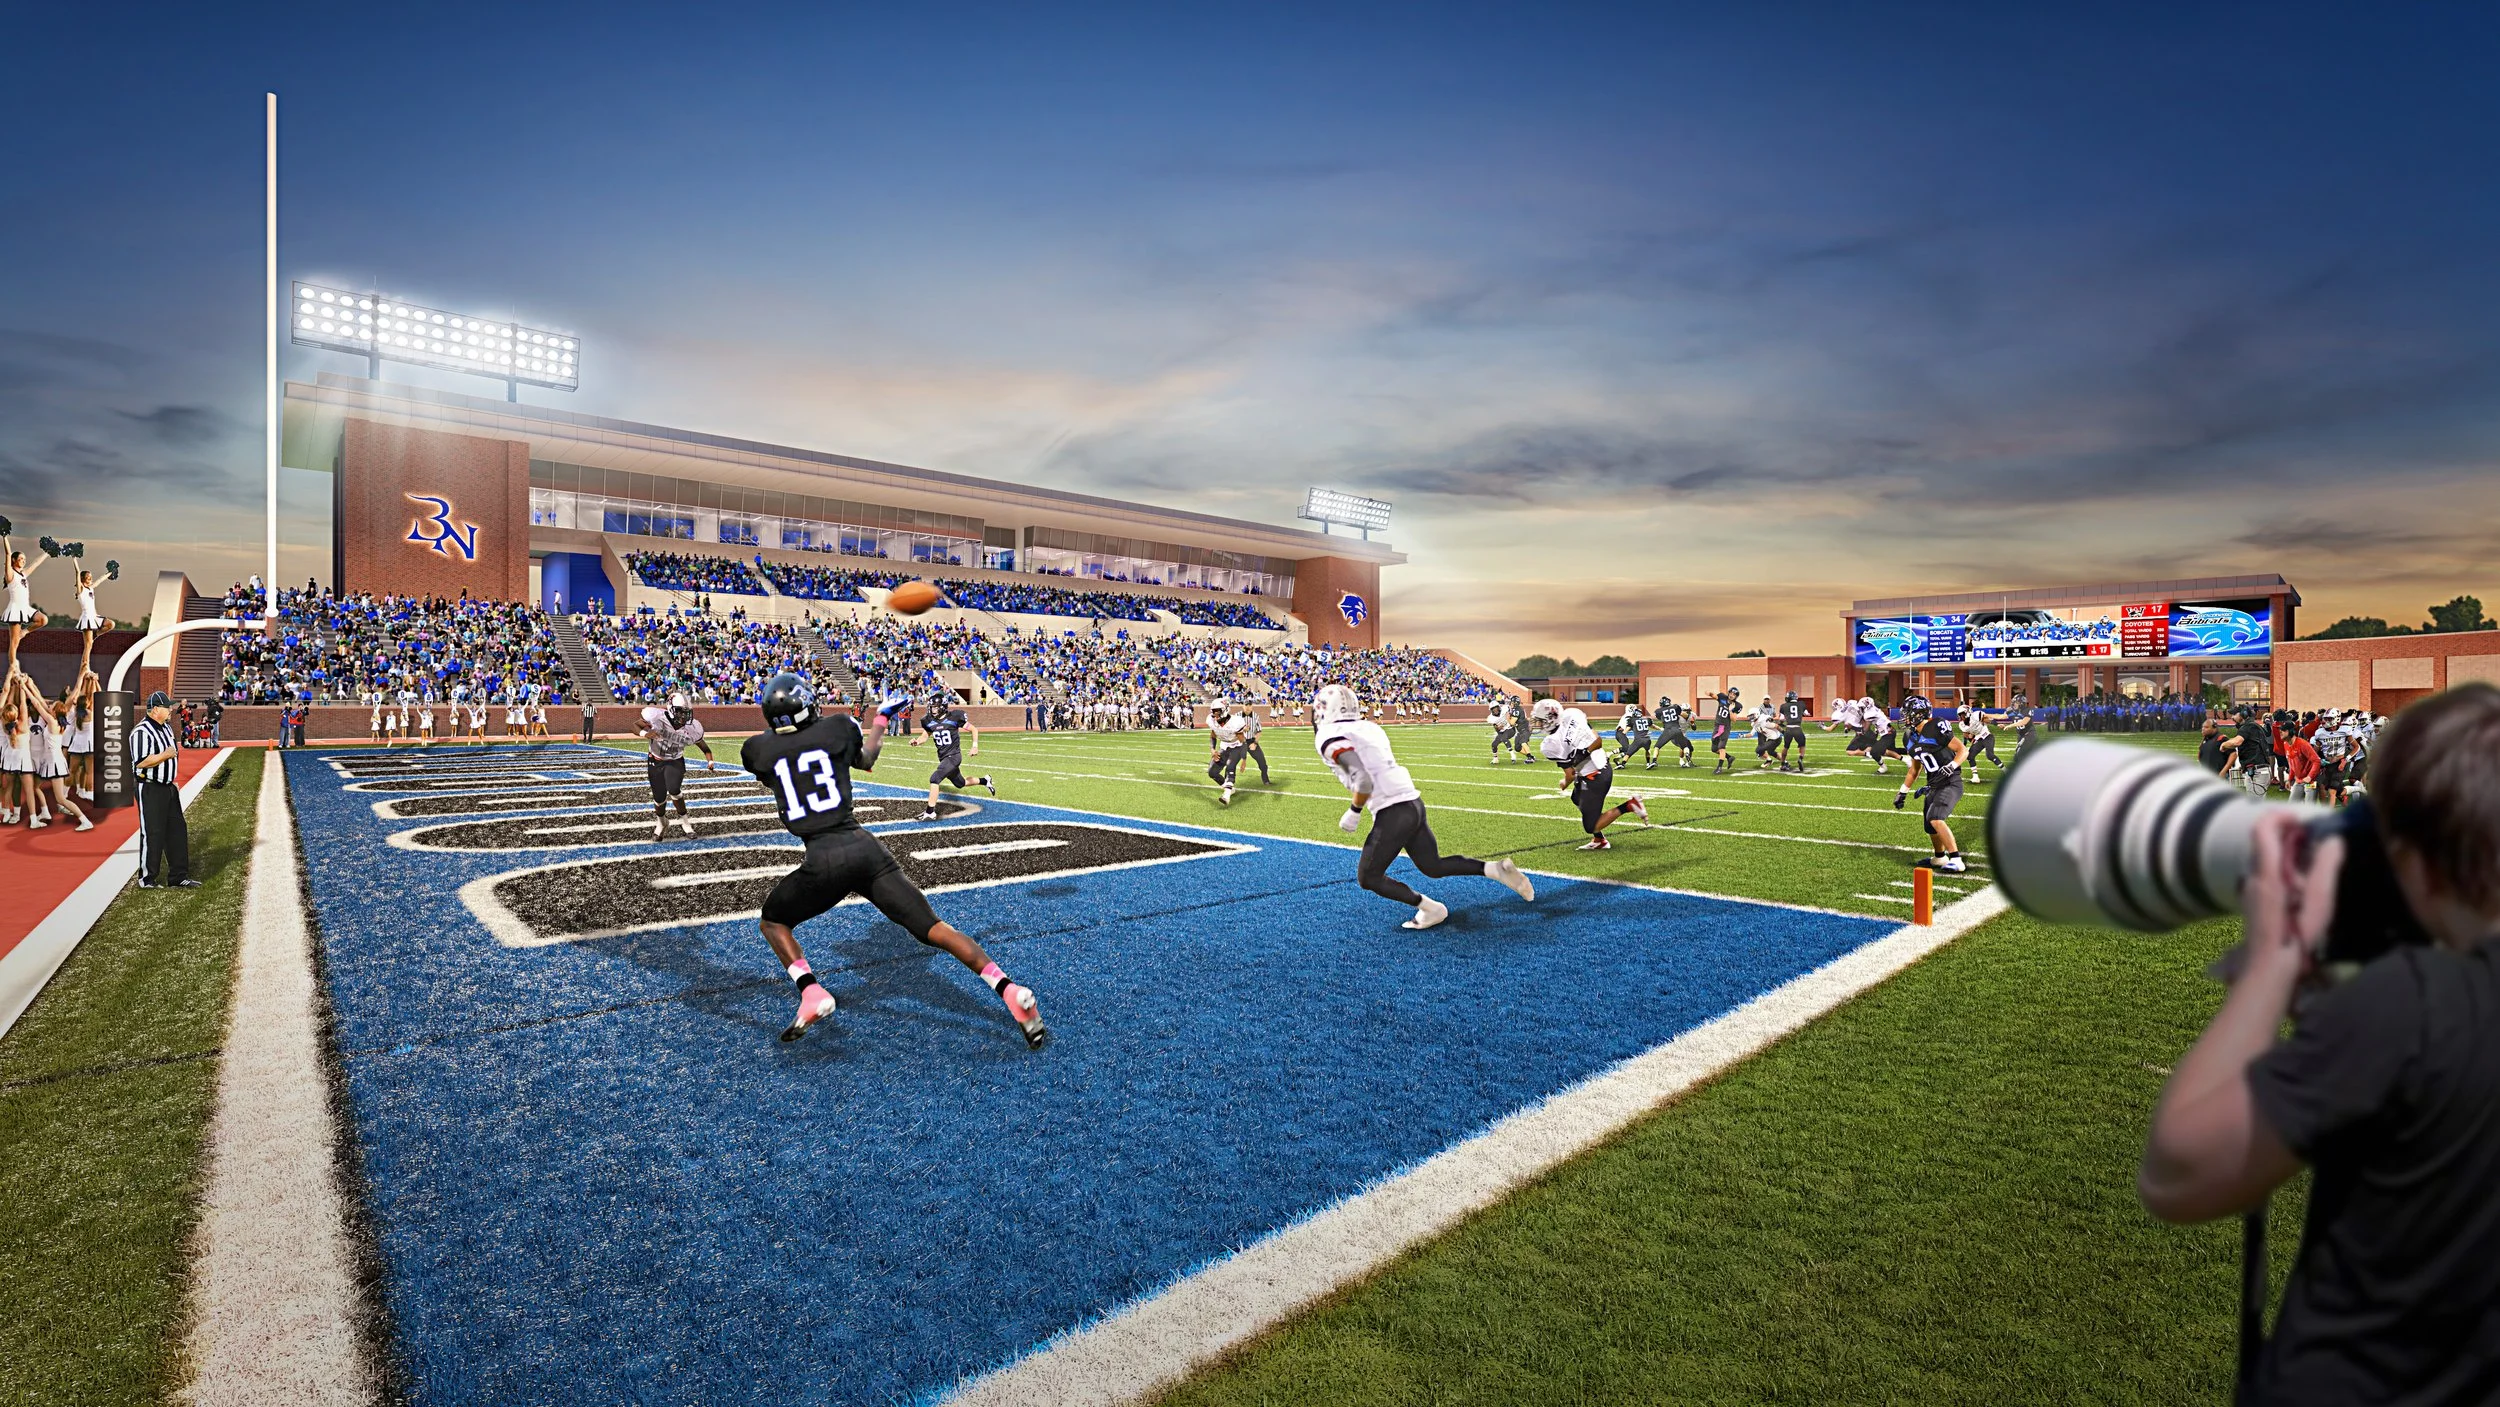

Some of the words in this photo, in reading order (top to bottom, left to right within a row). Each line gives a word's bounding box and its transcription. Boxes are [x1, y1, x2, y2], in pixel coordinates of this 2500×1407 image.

[2151, 605, 2163, 613] 17
[2099, 646, 2108, 654] 17
[1662, 708, 1678, 723] 52
[1718, 706, 1729, 718] 10
[1789, 705, 1798, 719] 9
[1635, 719, 1649, 731] 62
[1937, 719, 1953, 734] 30
[103, 704, 122, 793] BOBCATS
[773, 749, 842, 822] 13
